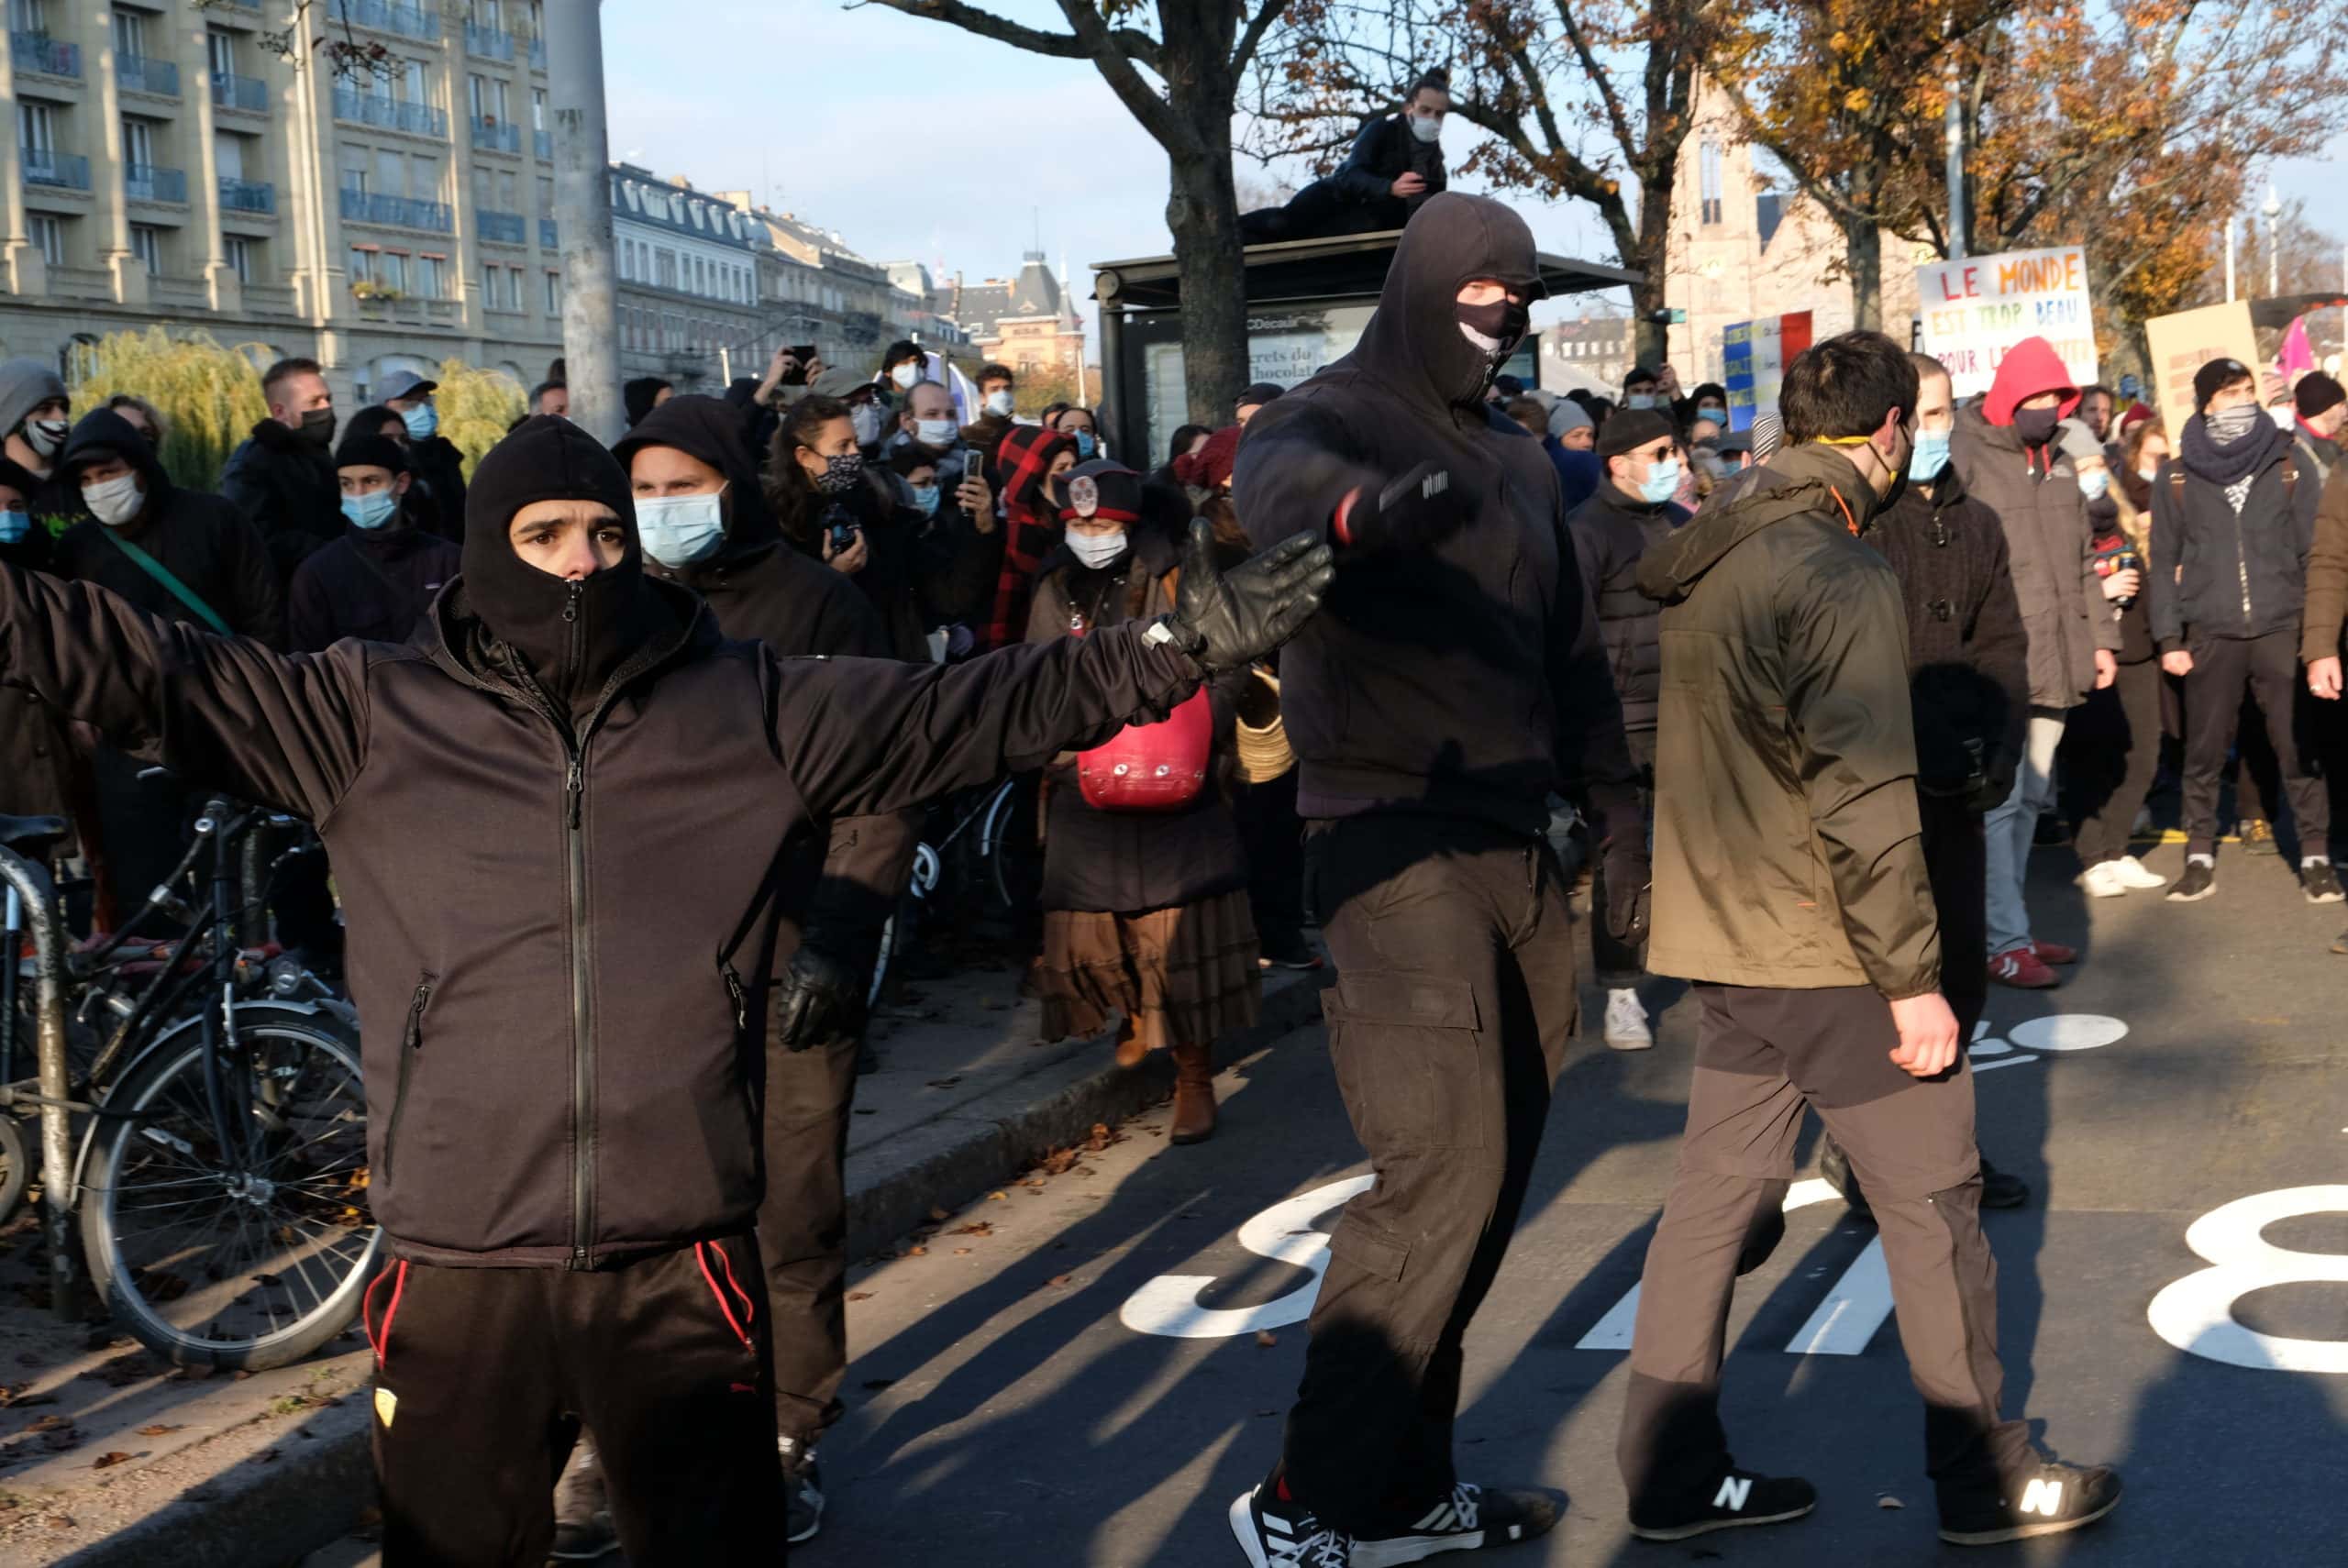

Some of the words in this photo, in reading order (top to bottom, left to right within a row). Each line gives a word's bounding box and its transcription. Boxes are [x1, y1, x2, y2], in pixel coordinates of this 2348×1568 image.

[1940, 267, 1980, 301] LE
[1998, 252, 2080, 295] MONDE
[1930, 308, 1966, 337] EST
[1976, 302, 2022, 330] TROP
[2035, 298, 2078, 326] BEAU
[1251, 363, 1312, 379] hocolat
[1712, 1475, 1753, 1511] N
[2020, 1478, 2063, 1516] N
